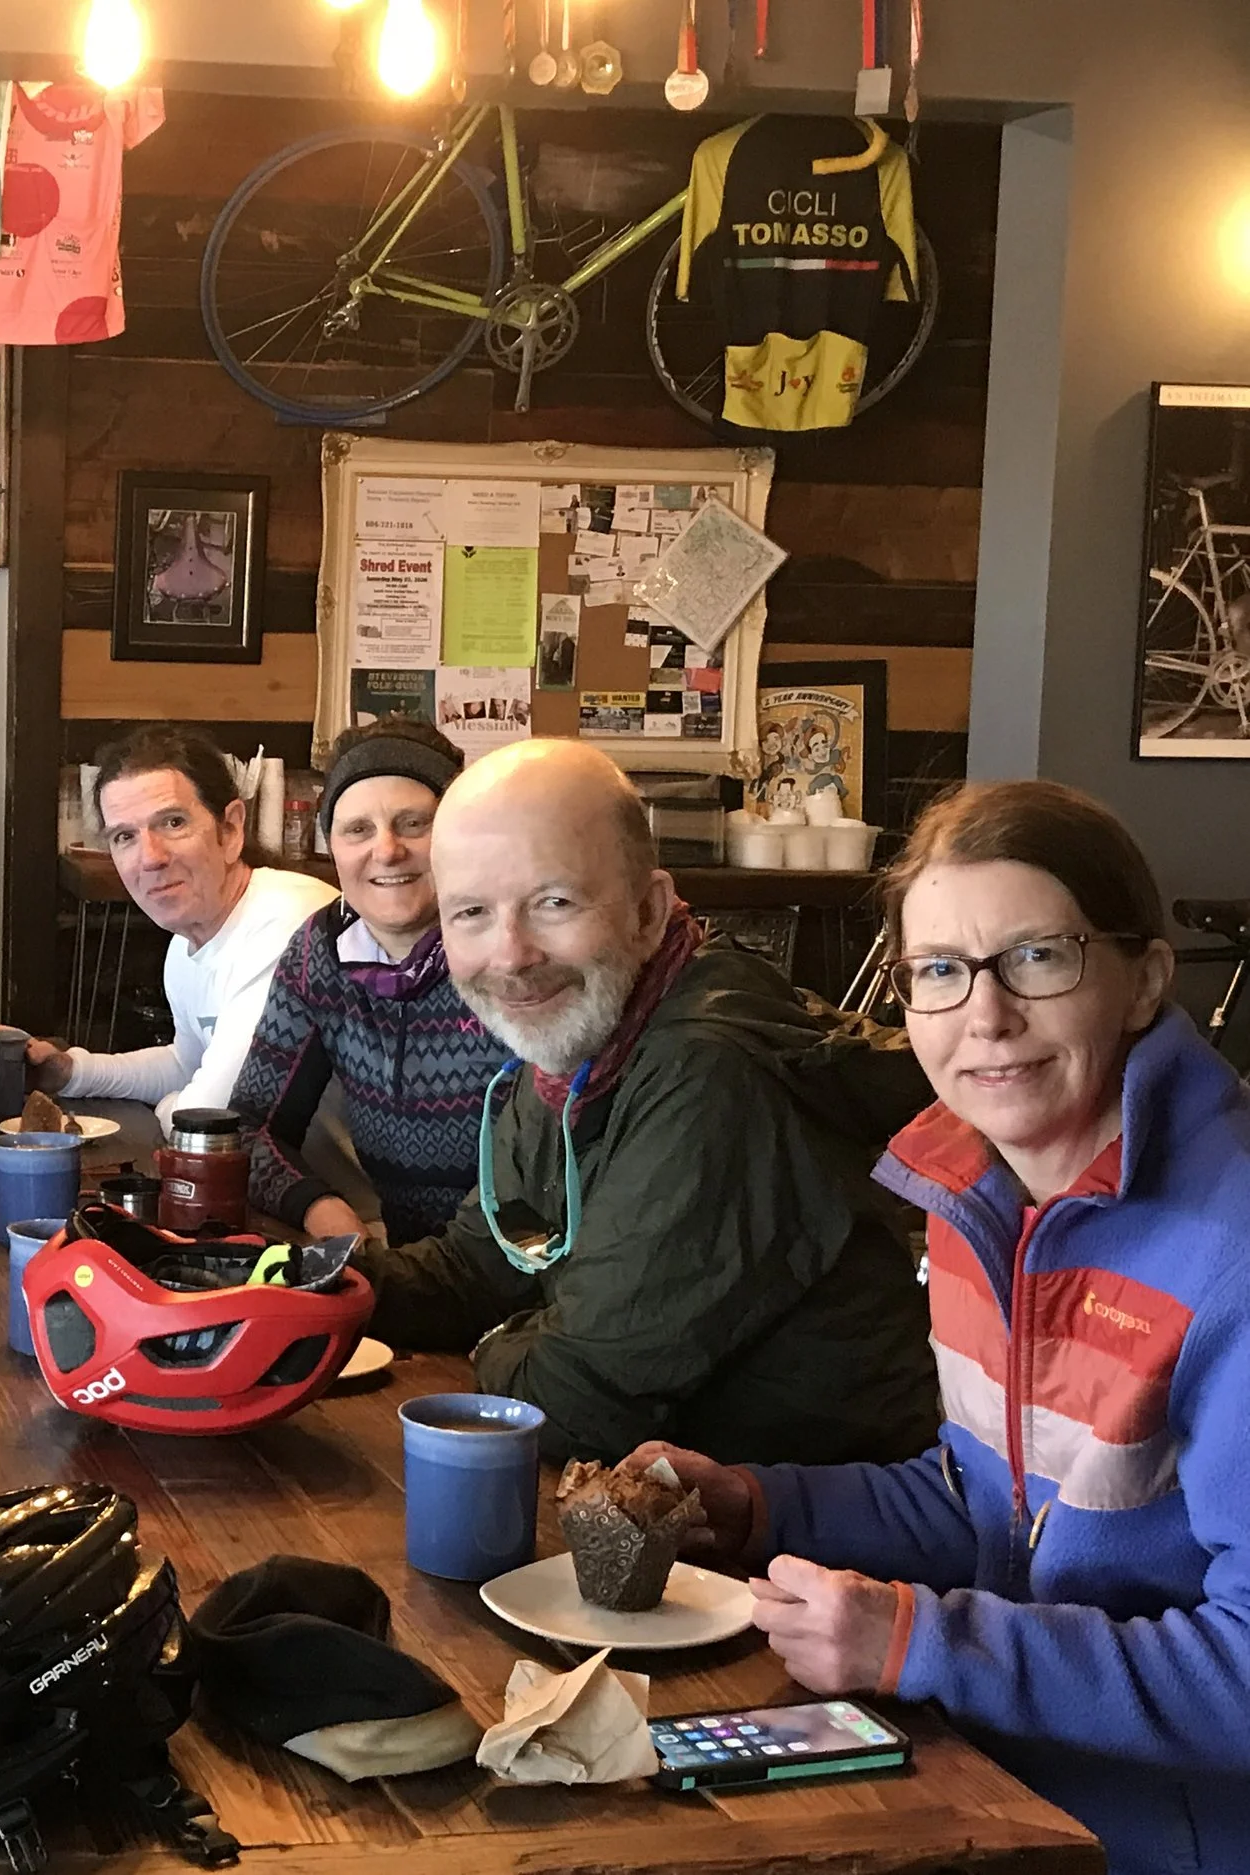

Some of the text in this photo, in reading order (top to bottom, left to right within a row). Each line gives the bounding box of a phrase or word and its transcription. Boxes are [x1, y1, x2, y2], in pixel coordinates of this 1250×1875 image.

[768, 189, 837, 217] CICLI
[732, 222, 869, 248] TOMASSO
[360, 558, 432, 573] Shred Event
[29, 1633, 109, 1695] GARNEAU
